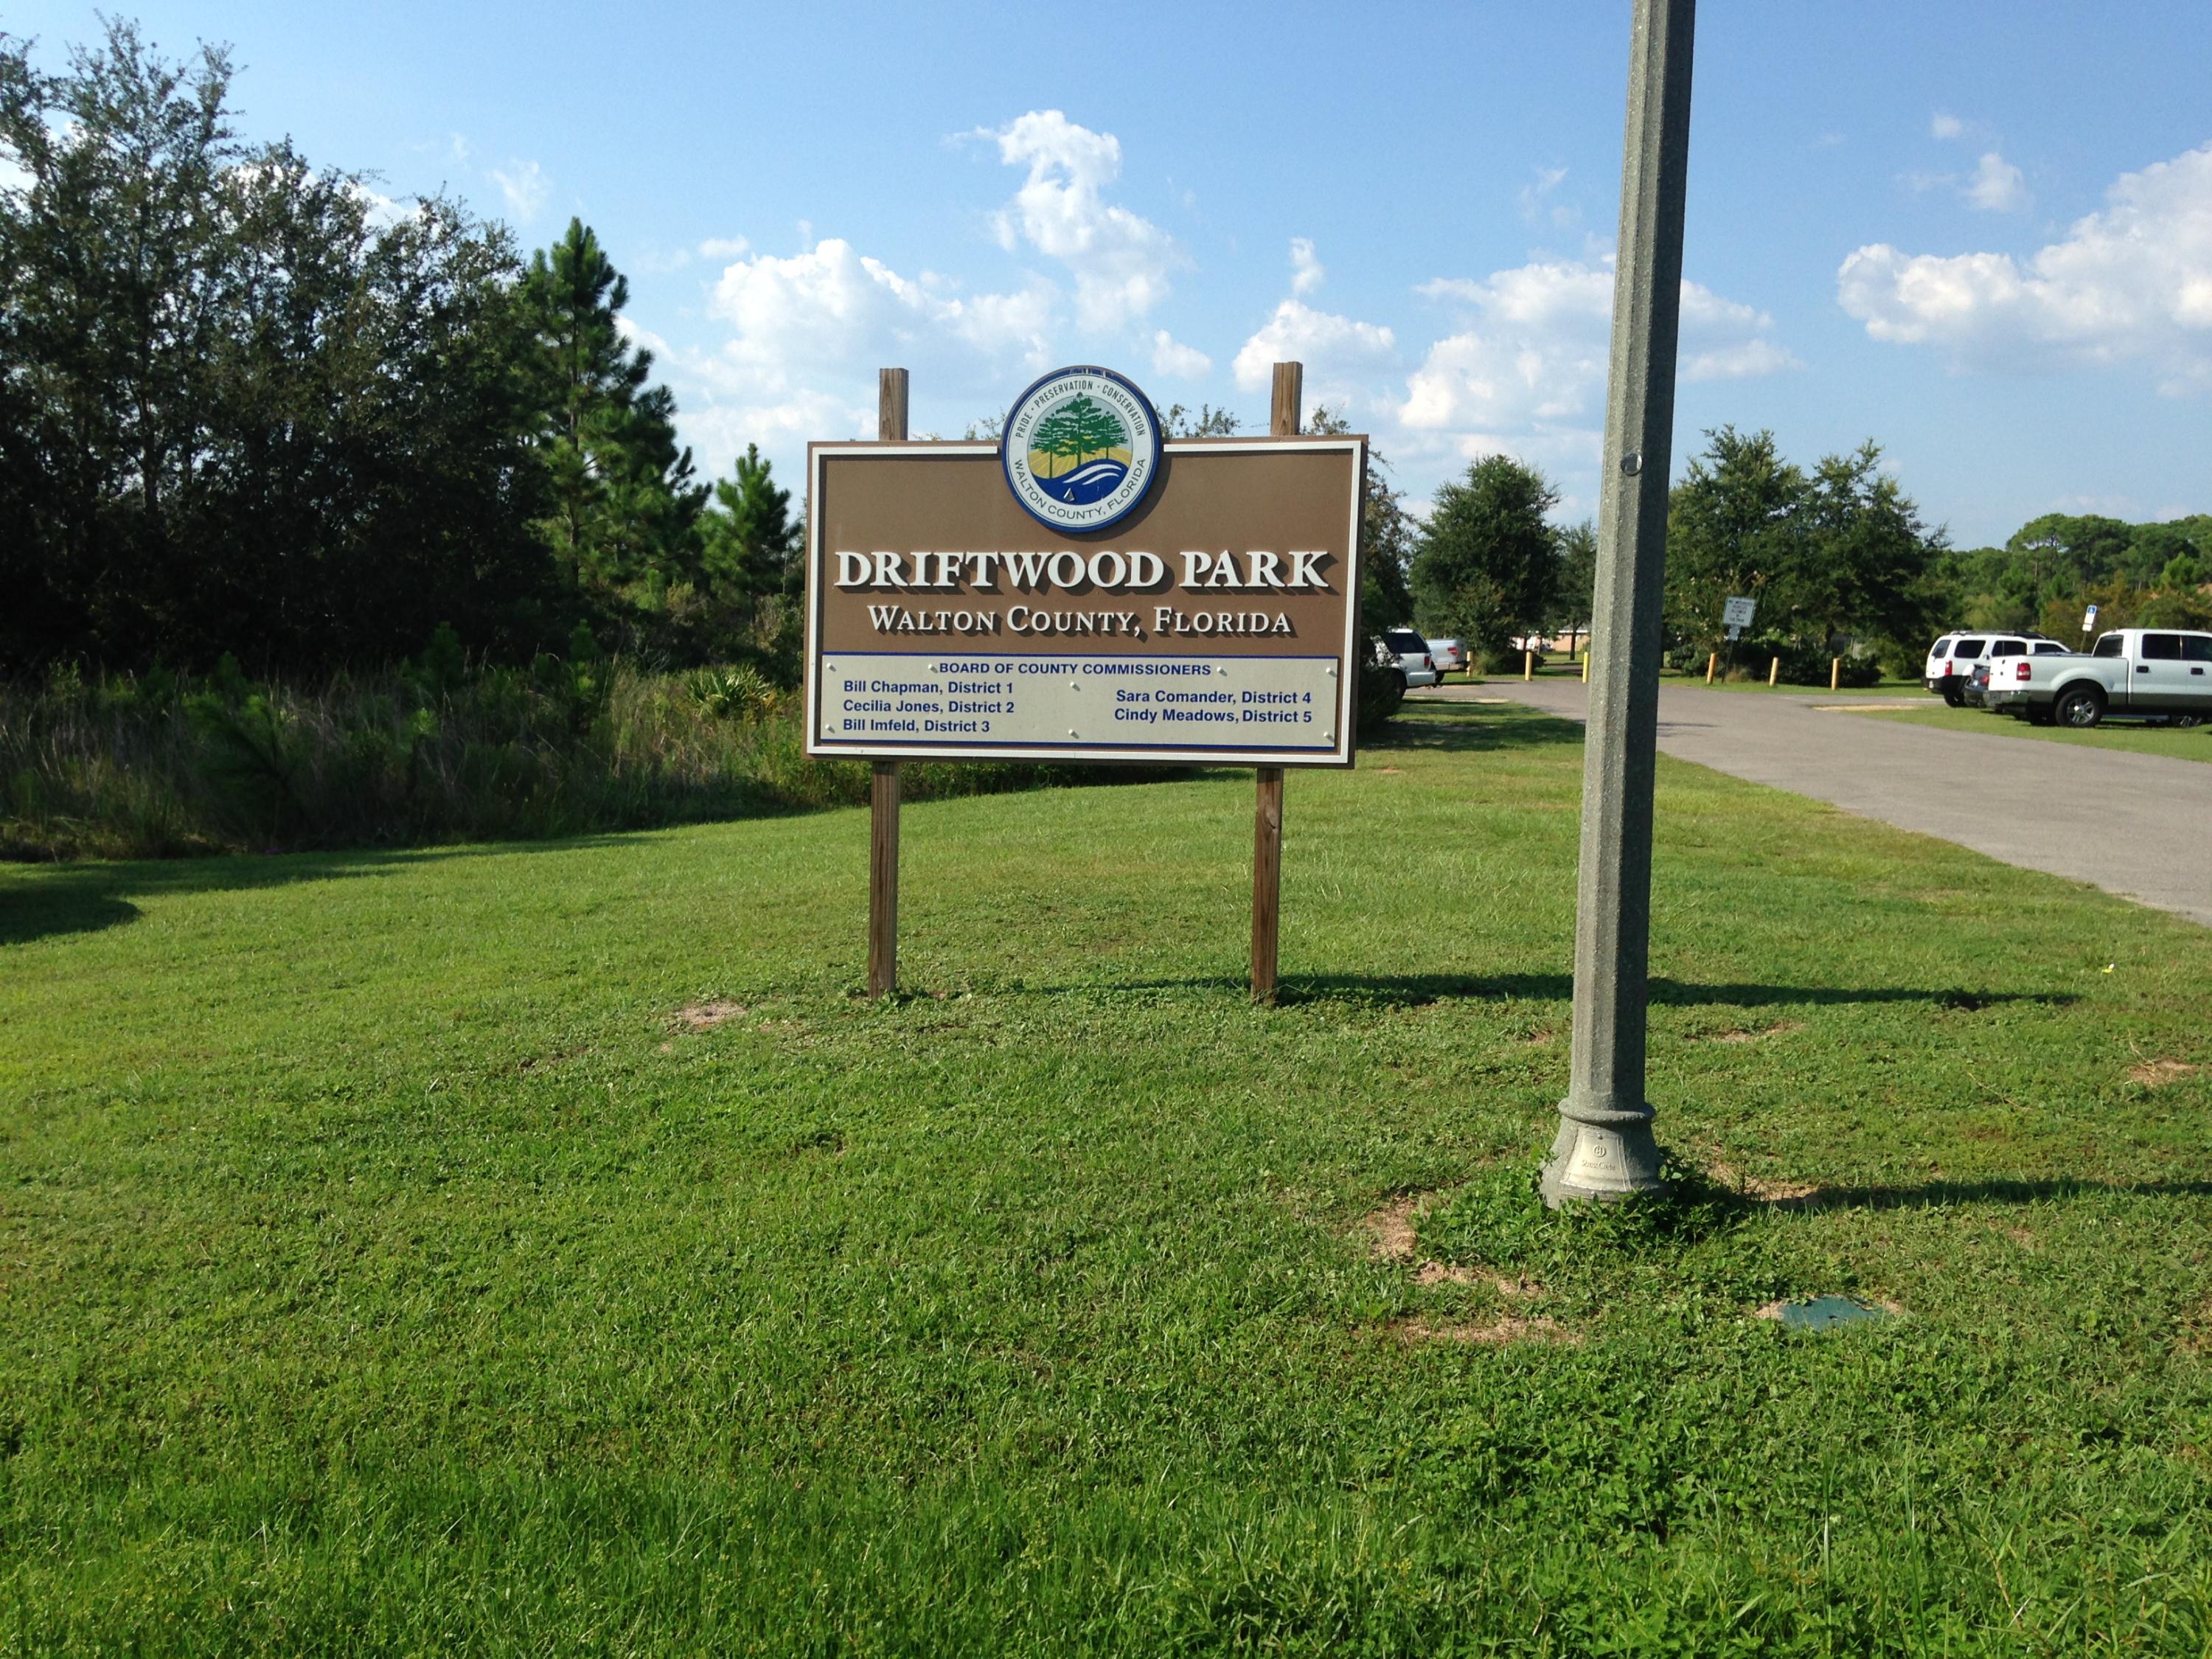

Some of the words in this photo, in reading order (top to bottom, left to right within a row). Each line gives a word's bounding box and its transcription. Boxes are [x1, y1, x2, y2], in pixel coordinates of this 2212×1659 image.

[1015, 412, 1033, 439] PRIDE
[1034, 380, 1093, 408] PRESERVATION
[1102, 385, 1146, 437] CONSERVATION
[1014, 459, 1047, 508] WALTON
[1048, 504, 1106, 519] COUNTY,
[1108, 459, 1146, 510] FLORIDA
[834, 551, 1164, 588] DRIFTWOOD
[1179, 550, 1329, 588] PARK
[866, 605, 995, 630] WALTON
[1006, 605, 1141, 636] COUNTY,
[1153, 606, 1291, 633] FLORIDA
[939, 663, 990, 673] BOARD
[995, 663, 1014, 673] OF
[1018, 664, 1078, 674] COUNTY
[1082, 664, 1211, 675] COMMISSIONERS
[844, 680, 866, 692] Bill
[871, 681, 943, 695] Chapman,
[948, 681, 1001, 694] District
[1006, 683, 1013, 694] 1
[1116, 689, 1150, 702] Sara
[1155, 690, 1237, 705] Comander,
[1242, 691, 1298, 703] District
[1302, 692, 1312, 703] 4
[844, 699, 891, 712] Cecilia
[896, 700, 944, 714] Jones,
[948, 700, 1001, 713] District
[1006, 702, 1015, 714] 2
[1114, 708, 1158, 723] Cindy
[1163, 709, 1239, 723] Meadows,
[1242, 710, 1298, 723] District
[1303, 711, 1312, 723] 5
[843, 719, 866, 731] Bill
[870, 720, 919, 733] Imfeld,
[925, 720, 978, 732] District
[981, 721, 990, 732] 3
